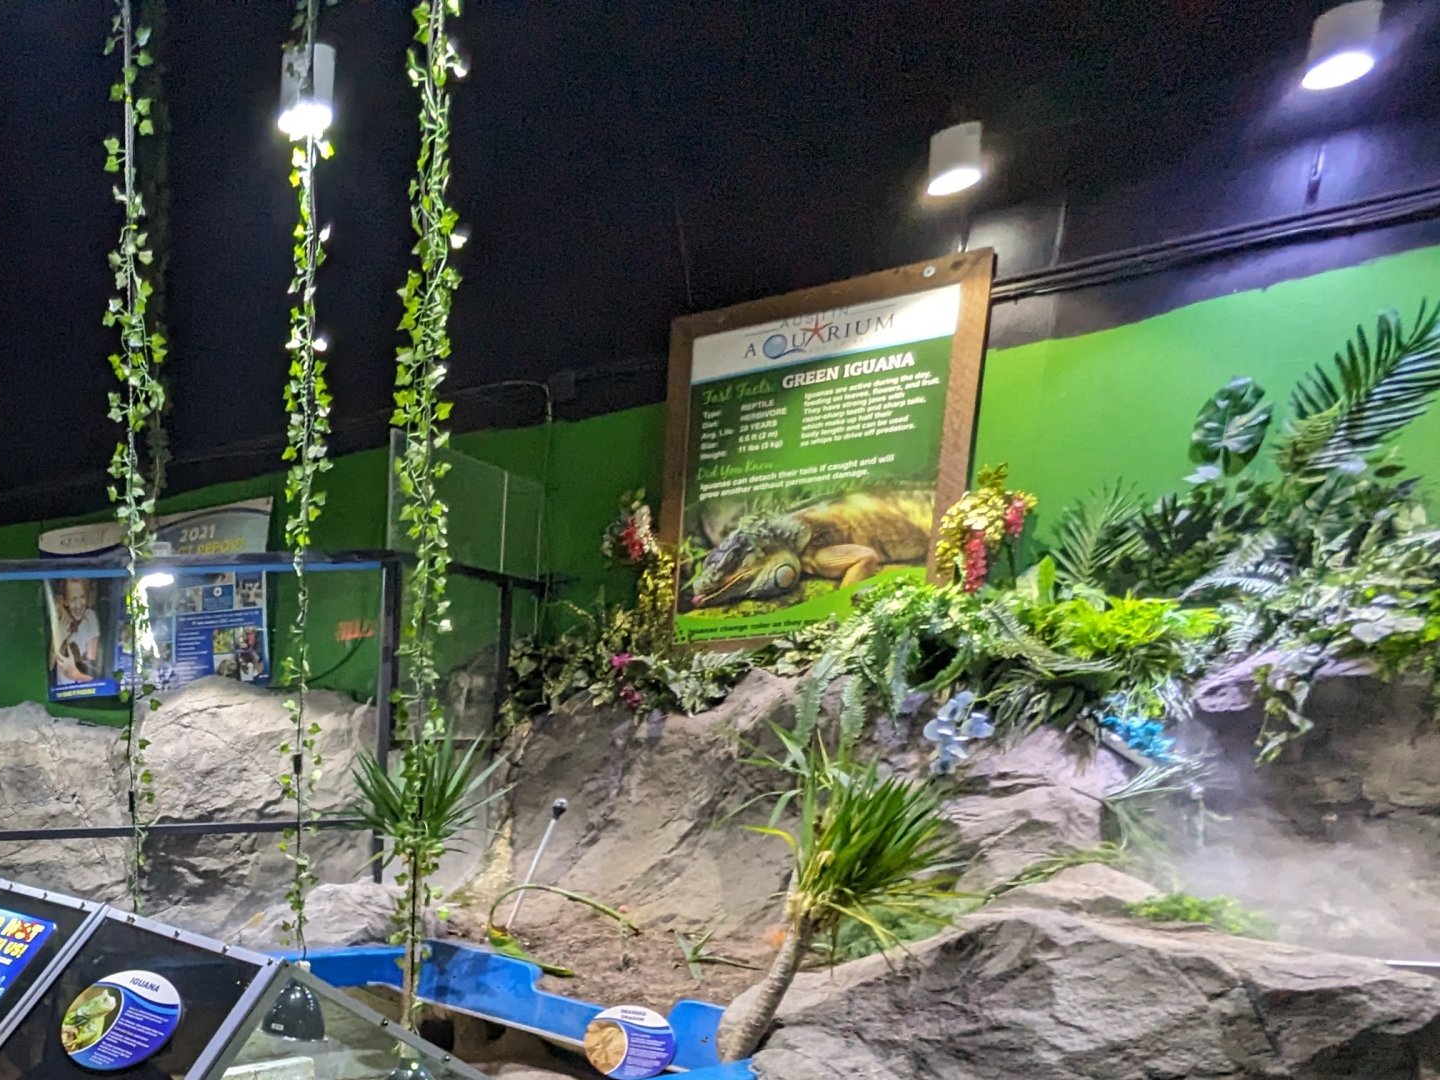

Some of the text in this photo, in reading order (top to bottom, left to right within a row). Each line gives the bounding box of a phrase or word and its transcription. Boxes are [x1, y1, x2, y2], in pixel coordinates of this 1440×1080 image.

[744, 313, 895, 360] AQUARIUM
[782, 352, 915, 388] GREEN IGUANA
[805, 389, 834, 400] Iguanas
[835, 386, 848, 394] are
[849, 382, 872, 392] active
[873, 377, 899, 388] during
[900, 374, 914, 382] the
[905, 381, 921, 390] and
[740, 399, 775, 412] REPTILE
[804, 392, 905, 415] They have strong jaws with
[846, 407, 866, 416] teeth
[867, 404, 882, 413] and
[883, 400, 906, 410] sharp
[750, 419, 778, 430] YEARS
[802, 410, 893, 431] which make up half their
[820, 426, 845, 437] length
[846, 423, 860, 431] and
[861, 421, 876, 430] can
[877, 418, 888, 426] be
[889, 414, 909, 424] used
[864, 428, 875, 437] off
[876, 423, 916, 436] predators.
[700, 453, 896, 491] Iguanas can detach their tails if caught and will
[720, 463, 743, 479] You
[699, 468, 870, 501] grow another without permanent damage.
[178, 524, 216, 543] 2021
[0, 917, 46, 943] NOT
[3, 941, 30, 959] US!
[129, 976, 160, 993] IGUANA
